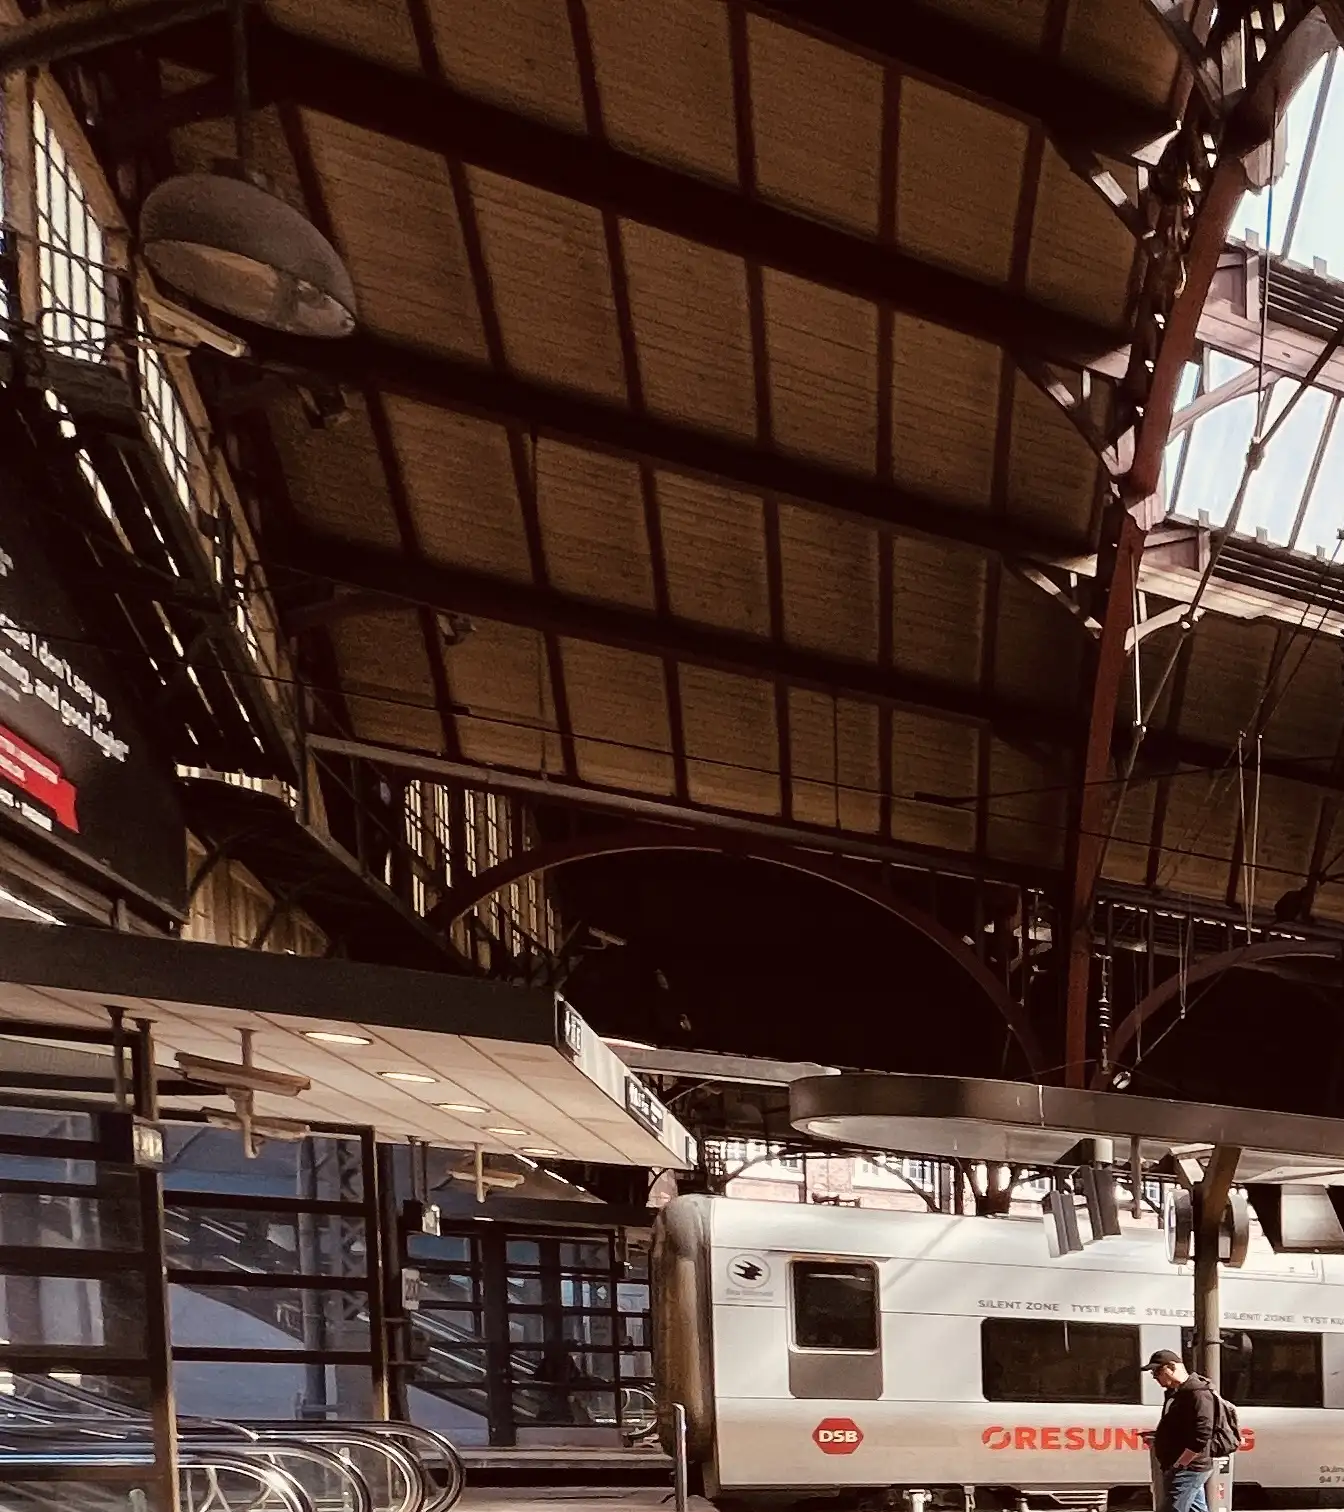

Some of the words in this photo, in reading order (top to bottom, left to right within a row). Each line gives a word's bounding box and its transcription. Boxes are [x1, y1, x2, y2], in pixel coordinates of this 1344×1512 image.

[977, 1299, 1022, 1311] SILENT
[1025, 1302, 1060, 1312] ZONE
[1070, 1304, 1100, 1314] TYST
[1223, 1311, 1261, 1321] SILENT
[1264, 1313, 1295, 1322] ZONE
[1302, 1315, 1328, 1325] TYST
[818, 1429, 858, 1443] DSB
